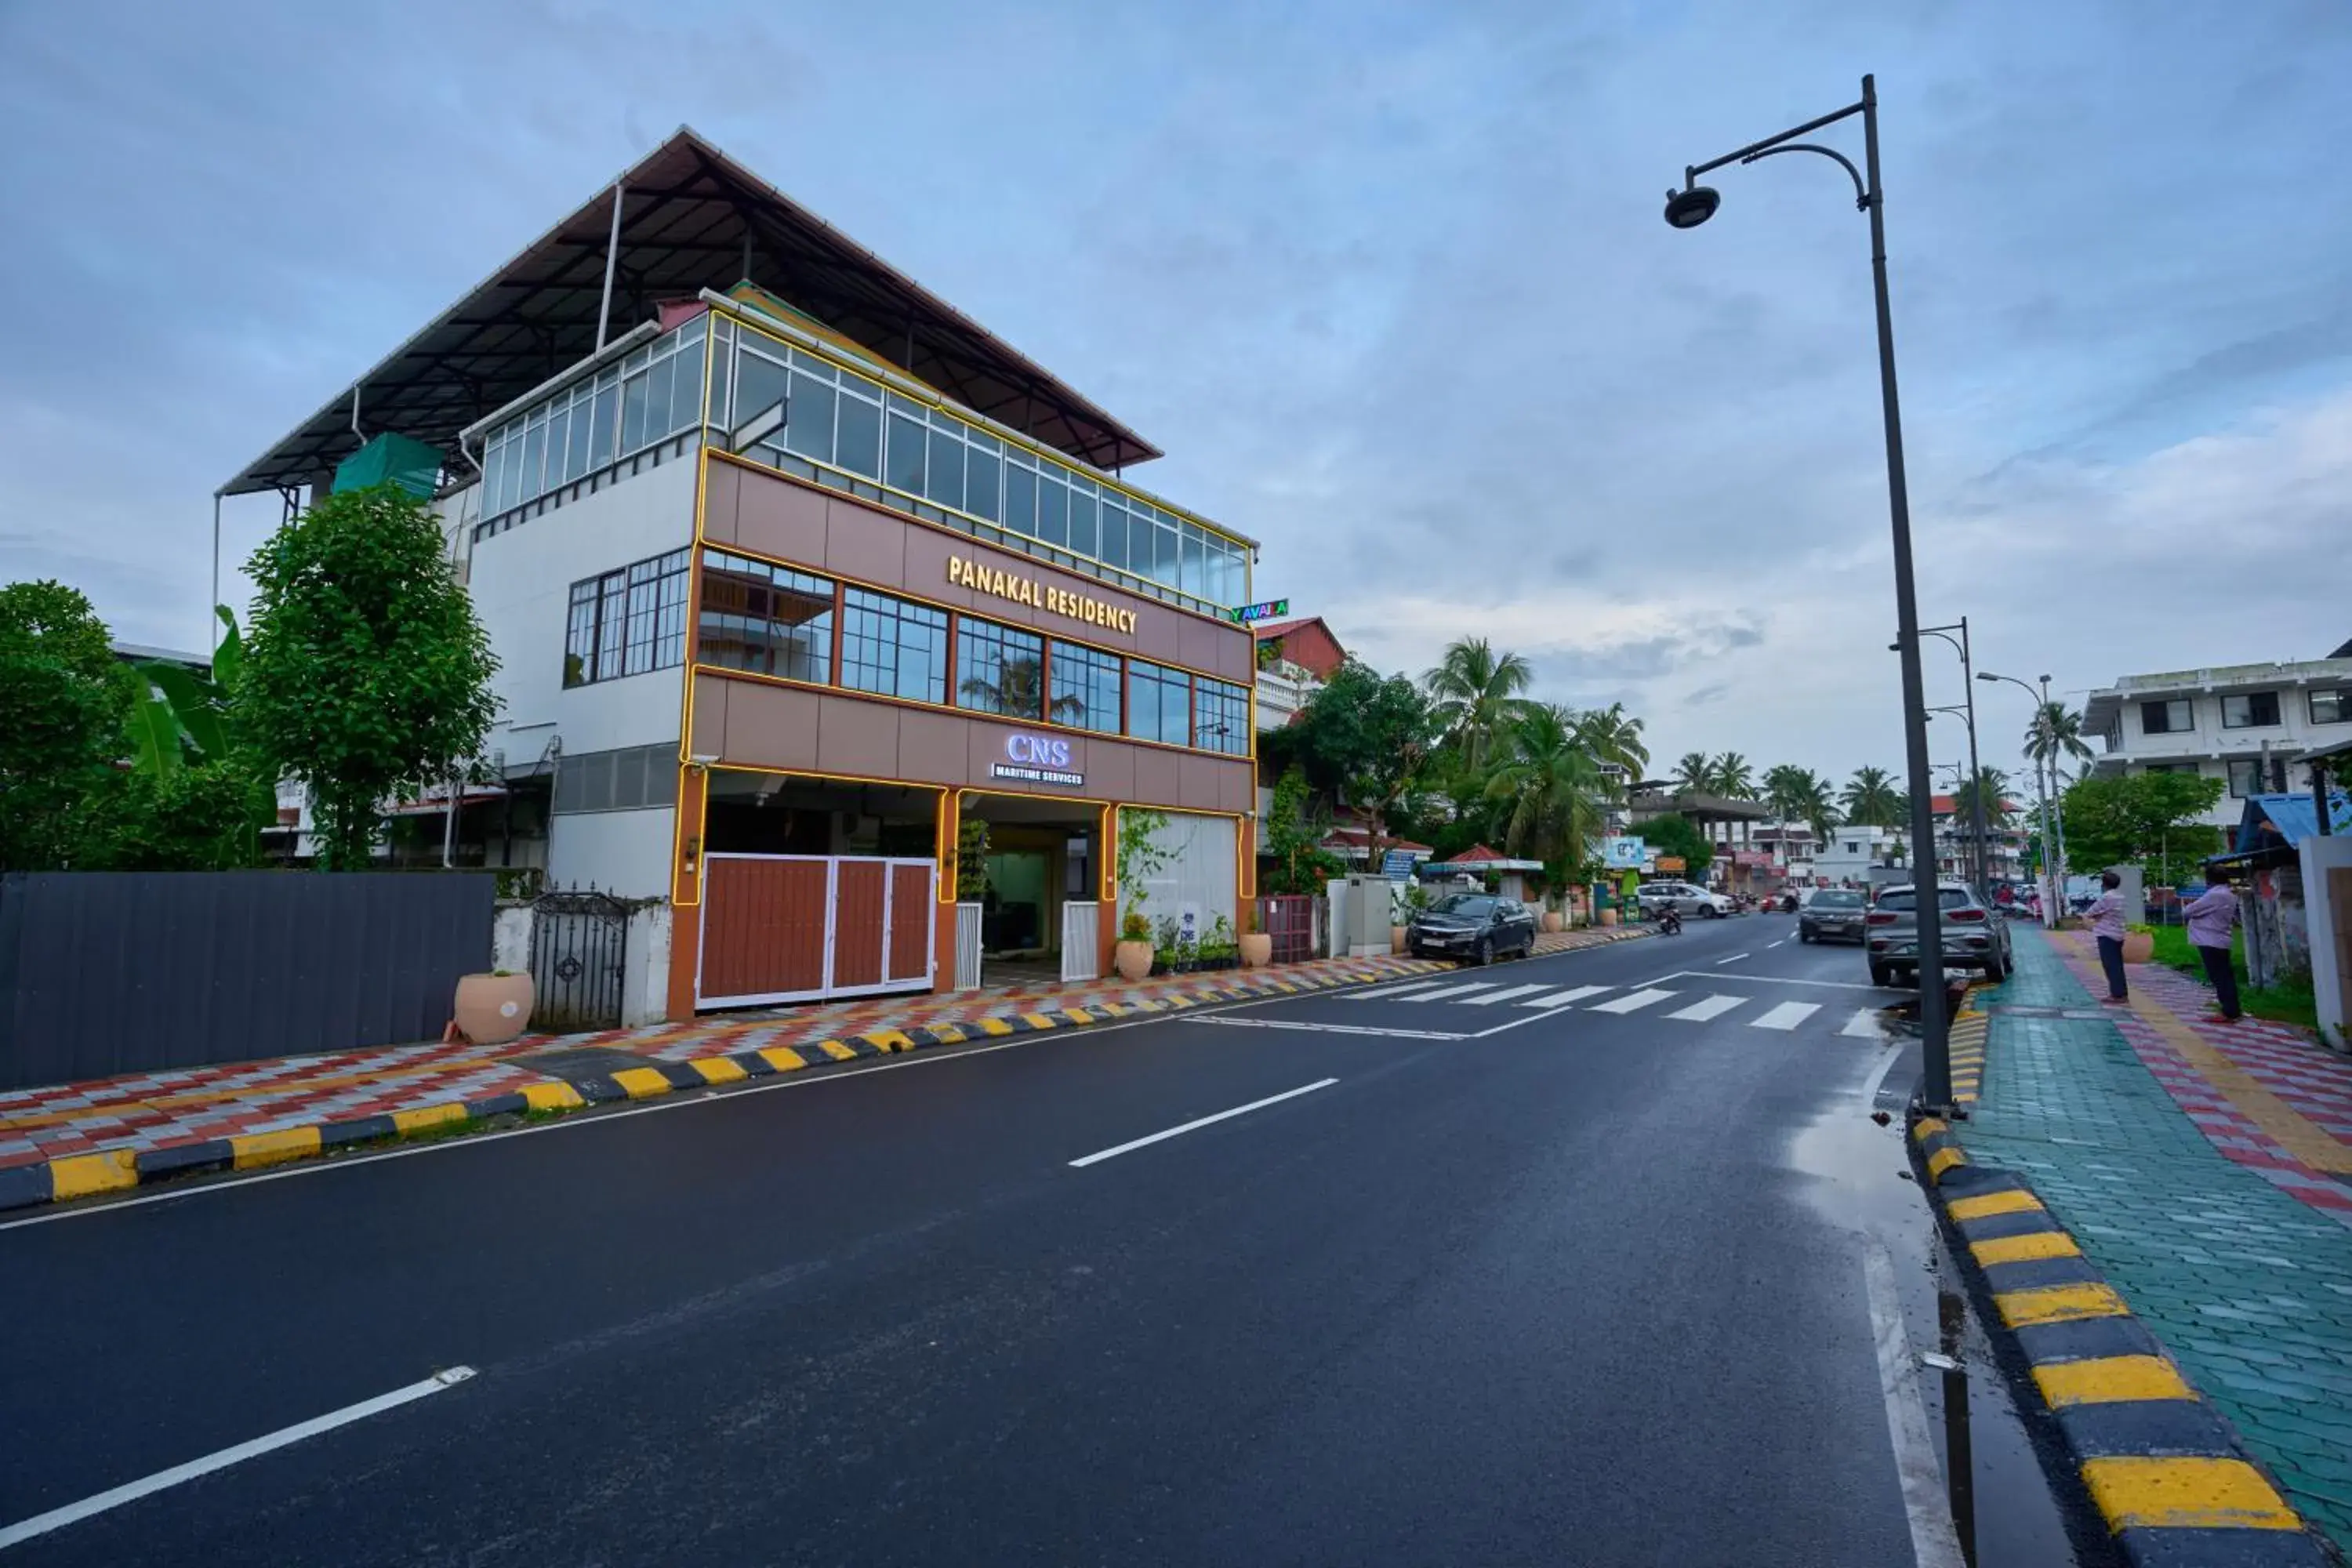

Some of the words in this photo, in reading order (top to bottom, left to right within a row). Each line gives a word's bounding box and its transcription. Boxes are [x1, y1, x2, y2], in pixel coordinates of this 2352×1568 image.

[949, 555, 1042, 608] PANAKAL
[1047, 586, 1137, 635] RESIDENCY
[1007, 734, 1069, 768] CNS
[996, 765, 1041, 781] MARITIME
[1042, 771, 1083, 785] SERVICES
